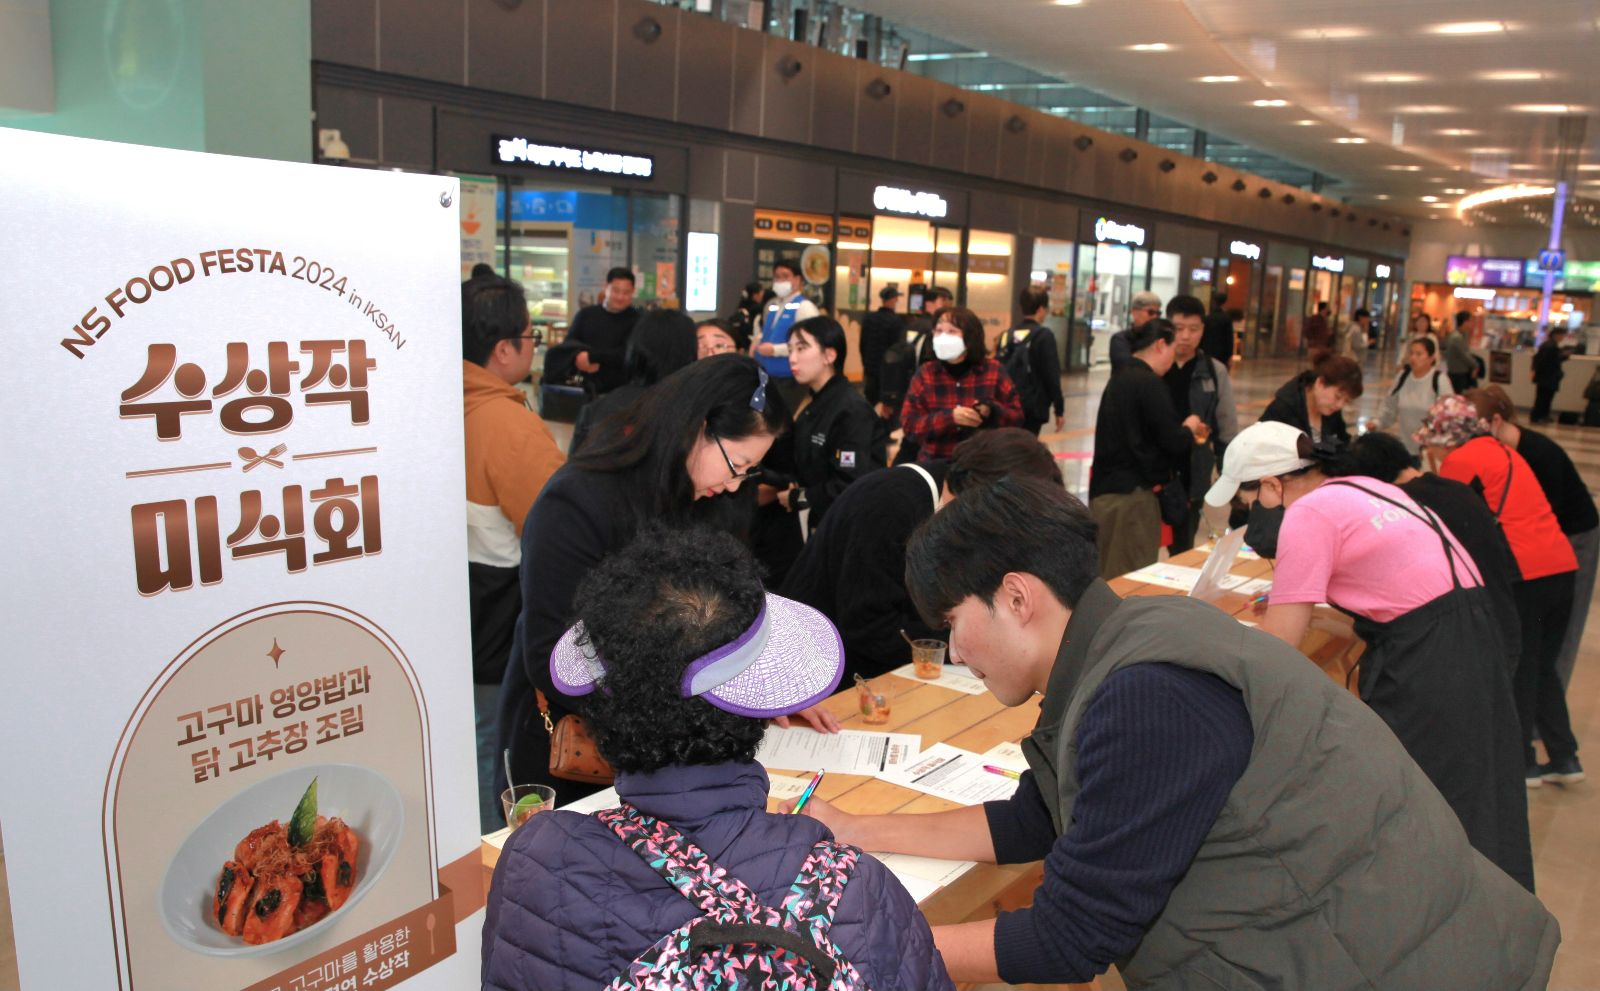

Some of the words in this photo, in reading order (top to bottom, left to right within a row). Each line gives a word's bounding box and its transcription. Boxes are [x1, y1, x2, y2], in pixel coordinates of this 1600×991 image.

[61, 307, 111, 360] NS
[105, 258, 195, 319] FOOD
[200, 248, 287, 276] FESTA
[291, 256, 348, 297] 2024
[348, 288, 362, 308] in
[363, 301, 406, 350] IKSAN
[119, 339, 377, 443] 수상작
[131, 475, 383, 598] 미식회
[176, 695, 264, 747] 고구마
[269, 665, 372, 719] 영양밥과
[191, 747, 221, 784] 닭
[229, 721, 308, 773] 고추장
[316, 704, 364, 745] 조림
[289, 950, 358, 991] 고구마를
[362, 926, 410, 964] 활용한
[362, 950, 410, 986] 수상작
